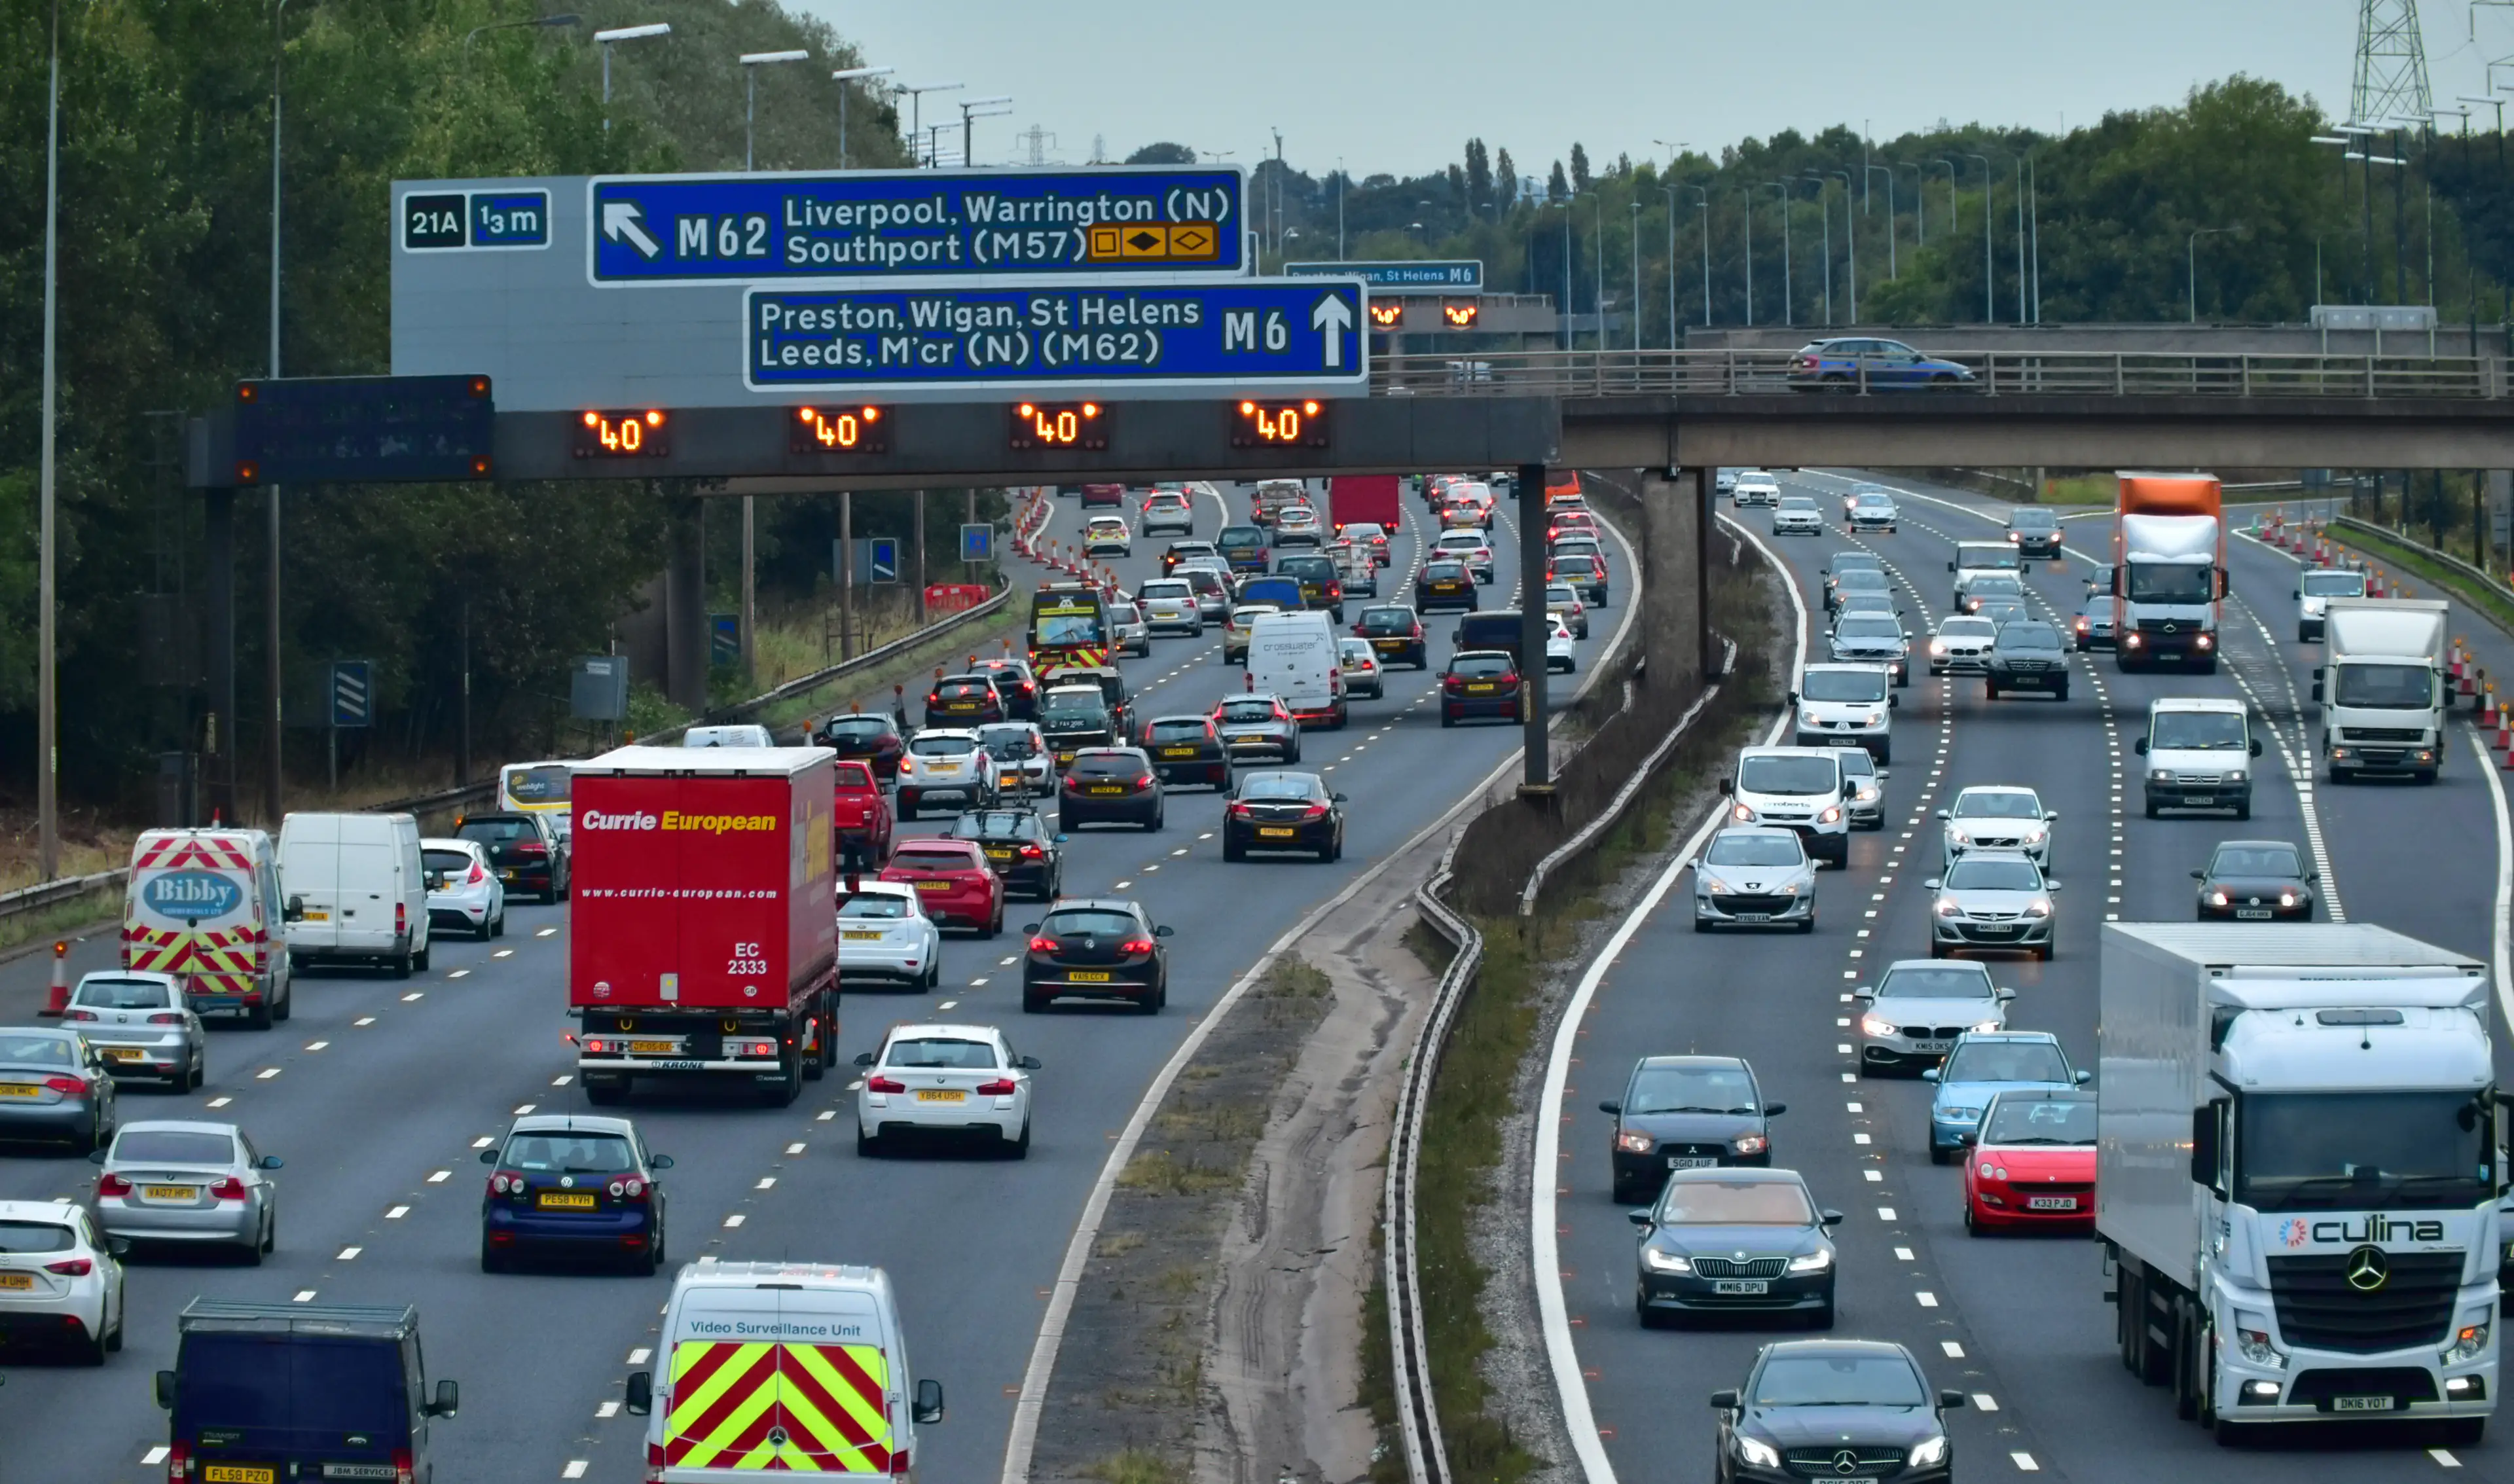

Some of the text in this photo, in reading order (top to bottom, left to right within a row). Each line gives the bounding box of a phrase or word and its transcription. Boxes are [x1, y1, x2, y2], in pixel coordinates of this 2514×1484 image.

[412, 211, 459, 234] 21A
[786, 188, 1230, 230] Liverpool, Warrington (N)
[678, 217, 767, 257] M62
[788, 228, 1087, 267] Southport (M57)
[1403, 270, 1444, 281] Helens
[1449, 268, 1472, 283] M6
[761, 297, 1199, 333] Preston, Wigan, St Helens
[1377, 309, 1394, 324] 40
[1451, 310, 1468, 325] 40
[1225, 311, 1286, 351] M6
[761, 338, 873, 367] Leeds,
[968, 331, 1029, 367] (N)
[1043, 328, 1159, 365] (M62)
[600, 418, 641, 450] 40
[816, 414, 857, 447] 40
[1036, 410, 1077, 443] 40
[1258, 409, 1298, 441] 40
[581, 810, 776, 835] Currie European
[154, 878, 233, 907] Bibby
[581, 888, 777, 901] www.currie-european.com
[735, 943, 759, 957] EC
[727, 960, 767, 974] 2333
[663, 1061, 706, 1070] KRONE
[2034, 1199, 2051, 1208] K33
[2312, 1214, 2444, 1243] culina
[691, 1321, 861, 1337] Video Surveillance Unit
[333, 1466, 394, 1476] JBM SERVICES
